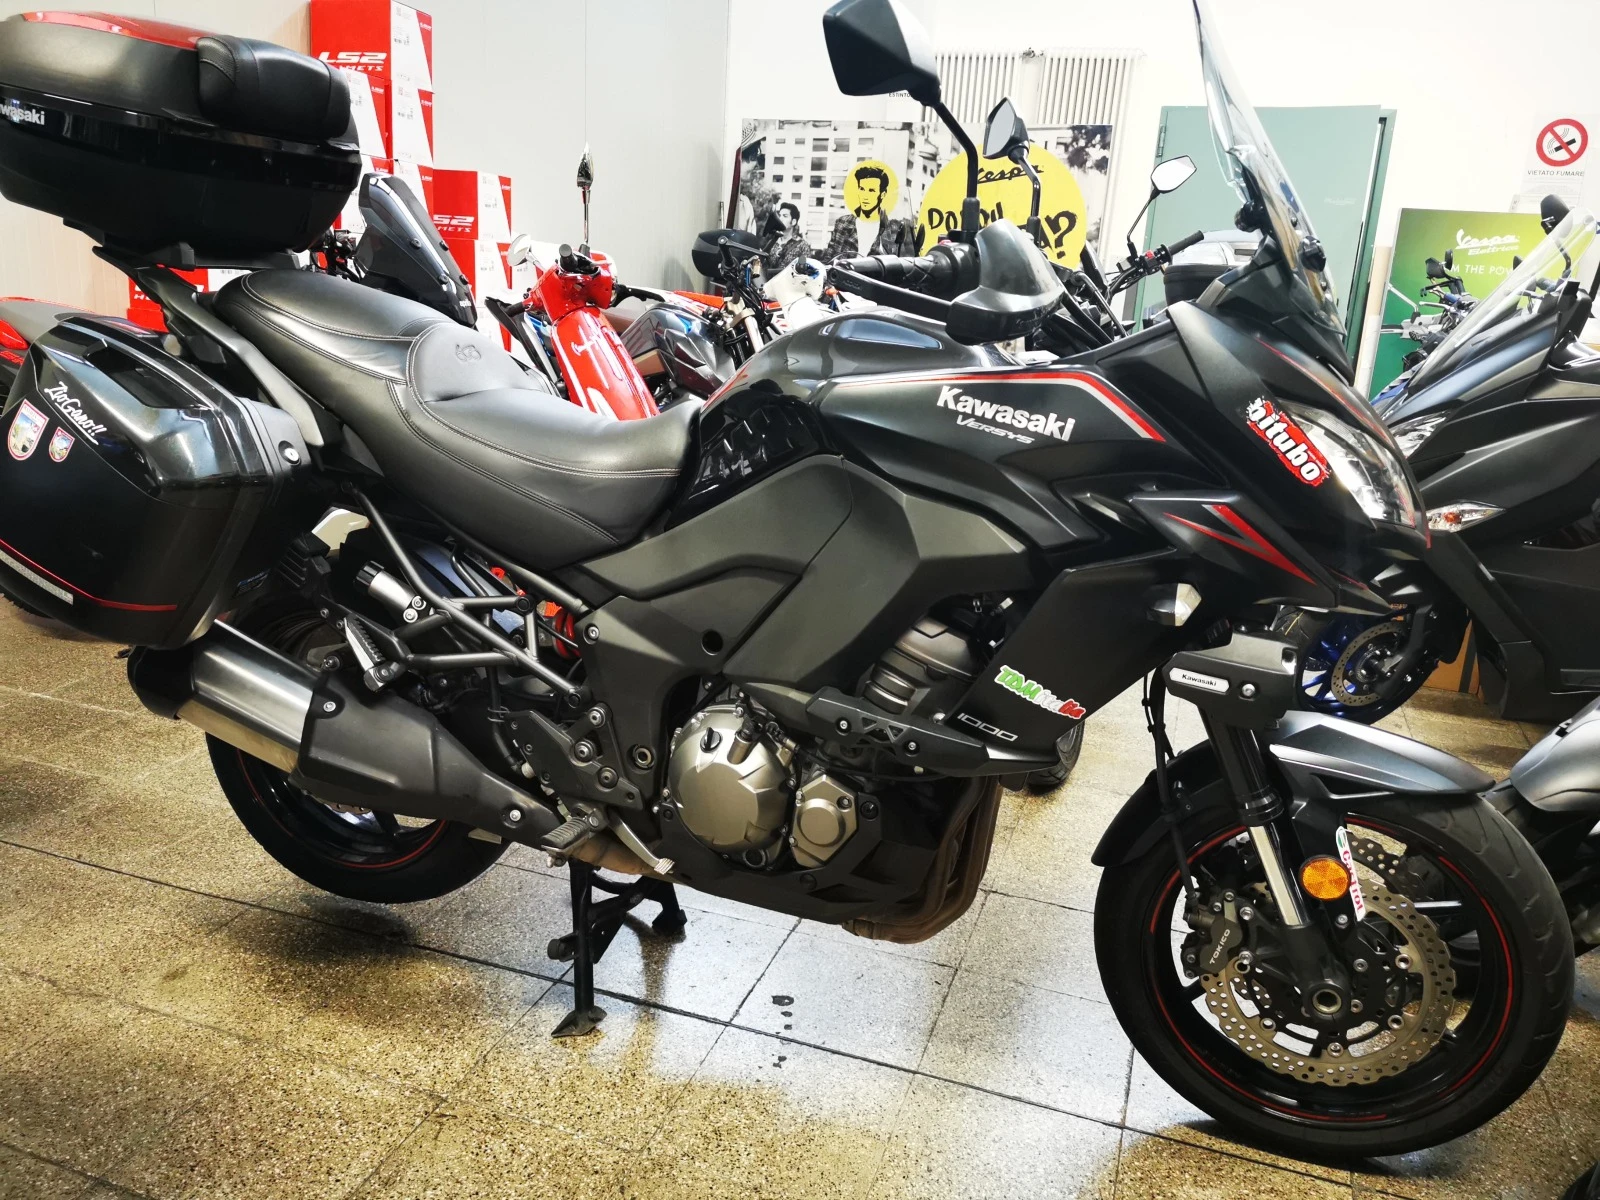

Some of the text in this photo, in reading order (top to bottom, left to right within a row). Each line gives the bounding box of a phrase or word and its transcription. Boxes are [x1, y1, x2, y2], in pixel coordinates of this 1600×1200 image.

[318, 51, 387, 64] LS2
[0, 103, 45, 125] wasaki
[433, 214, 475, 226] S2
[1455, 228, 1520, 250] Vespa
[1465, 264, 1485, 275] THE
[936, 385, 1076, 442] Kawasaki
[956, 414, 1035, 444] VERSYS
[1246, 396, 1321, 481] bitubo
[1182, 673, 1217, 687] Kawasaki
[957, 712, 1019, 742] 1000
[1209, 928, 1231, 965] TOKICO
